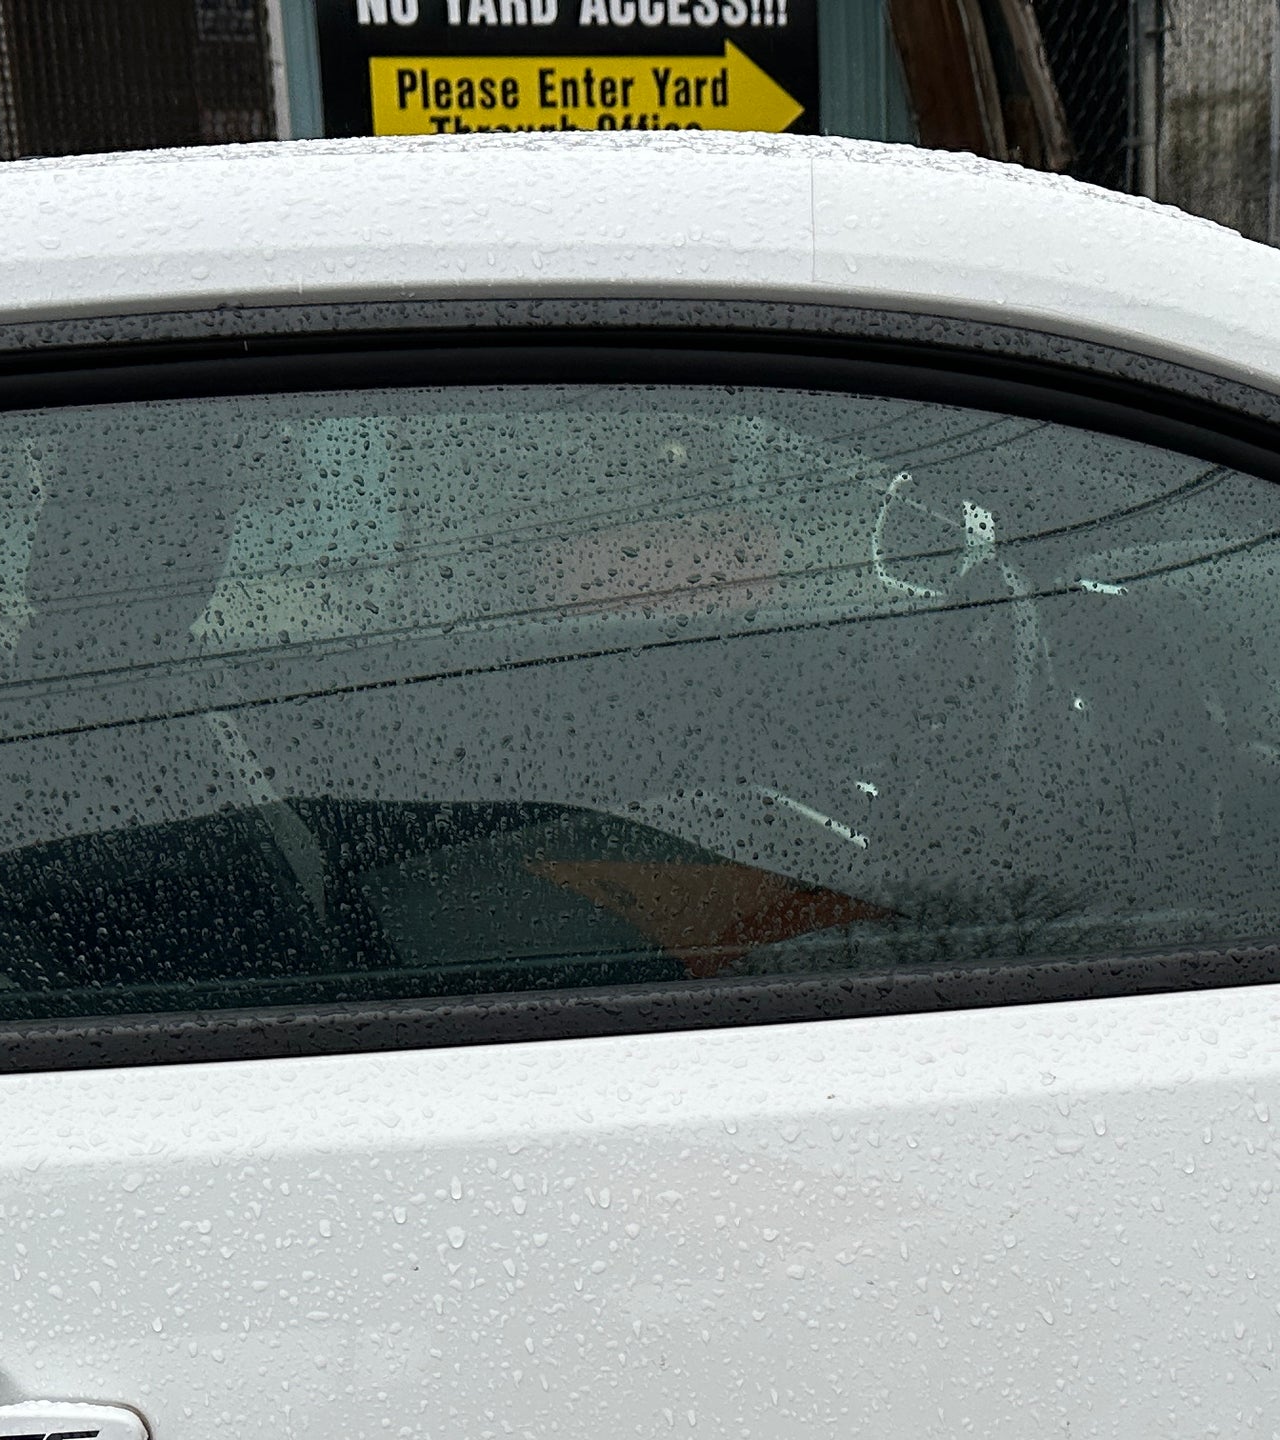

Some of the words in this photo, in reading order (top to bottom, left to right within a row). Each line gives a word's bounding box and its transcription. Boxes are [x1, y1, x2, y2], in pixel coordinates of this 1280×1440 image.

[396, 68, 520, 110] Please
[538, 67, 635, 109] Enter
[652, 66, 729, 108] Yard
